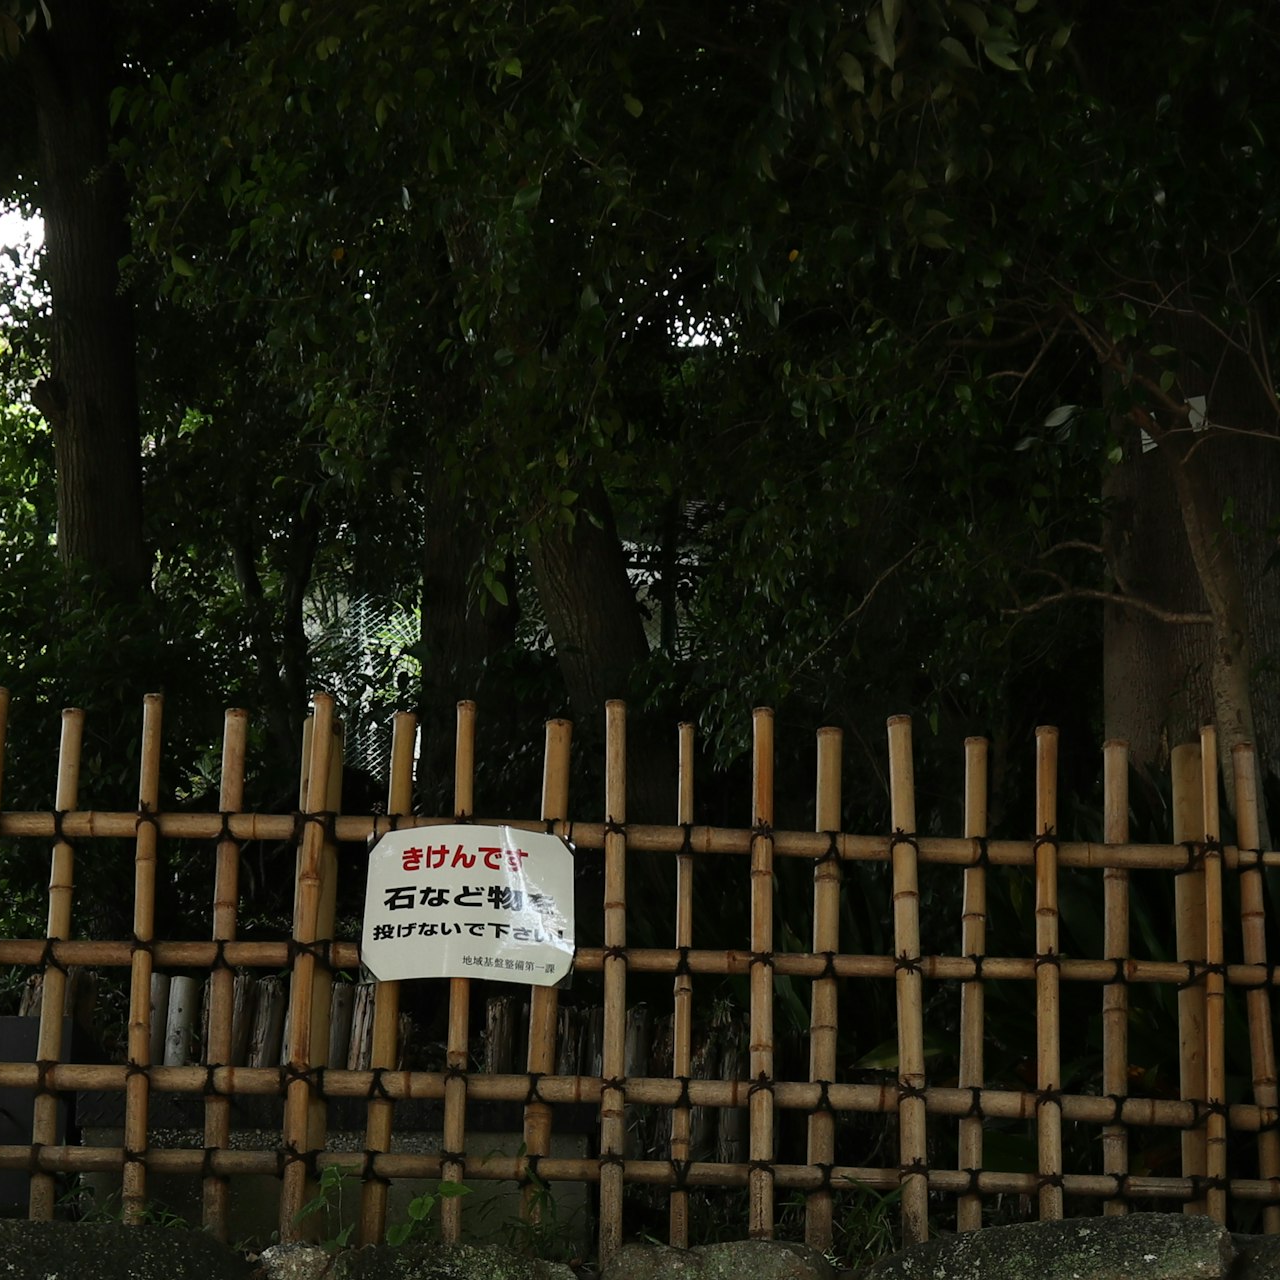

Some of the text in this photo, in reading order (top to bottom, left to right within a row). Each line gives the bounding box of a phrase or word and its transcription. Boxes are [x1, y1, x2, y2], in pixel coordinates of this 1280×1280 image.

[402, 844, 529, 872] きけんです
[461, 955, 555, 974] 地域基盤整備第一課
